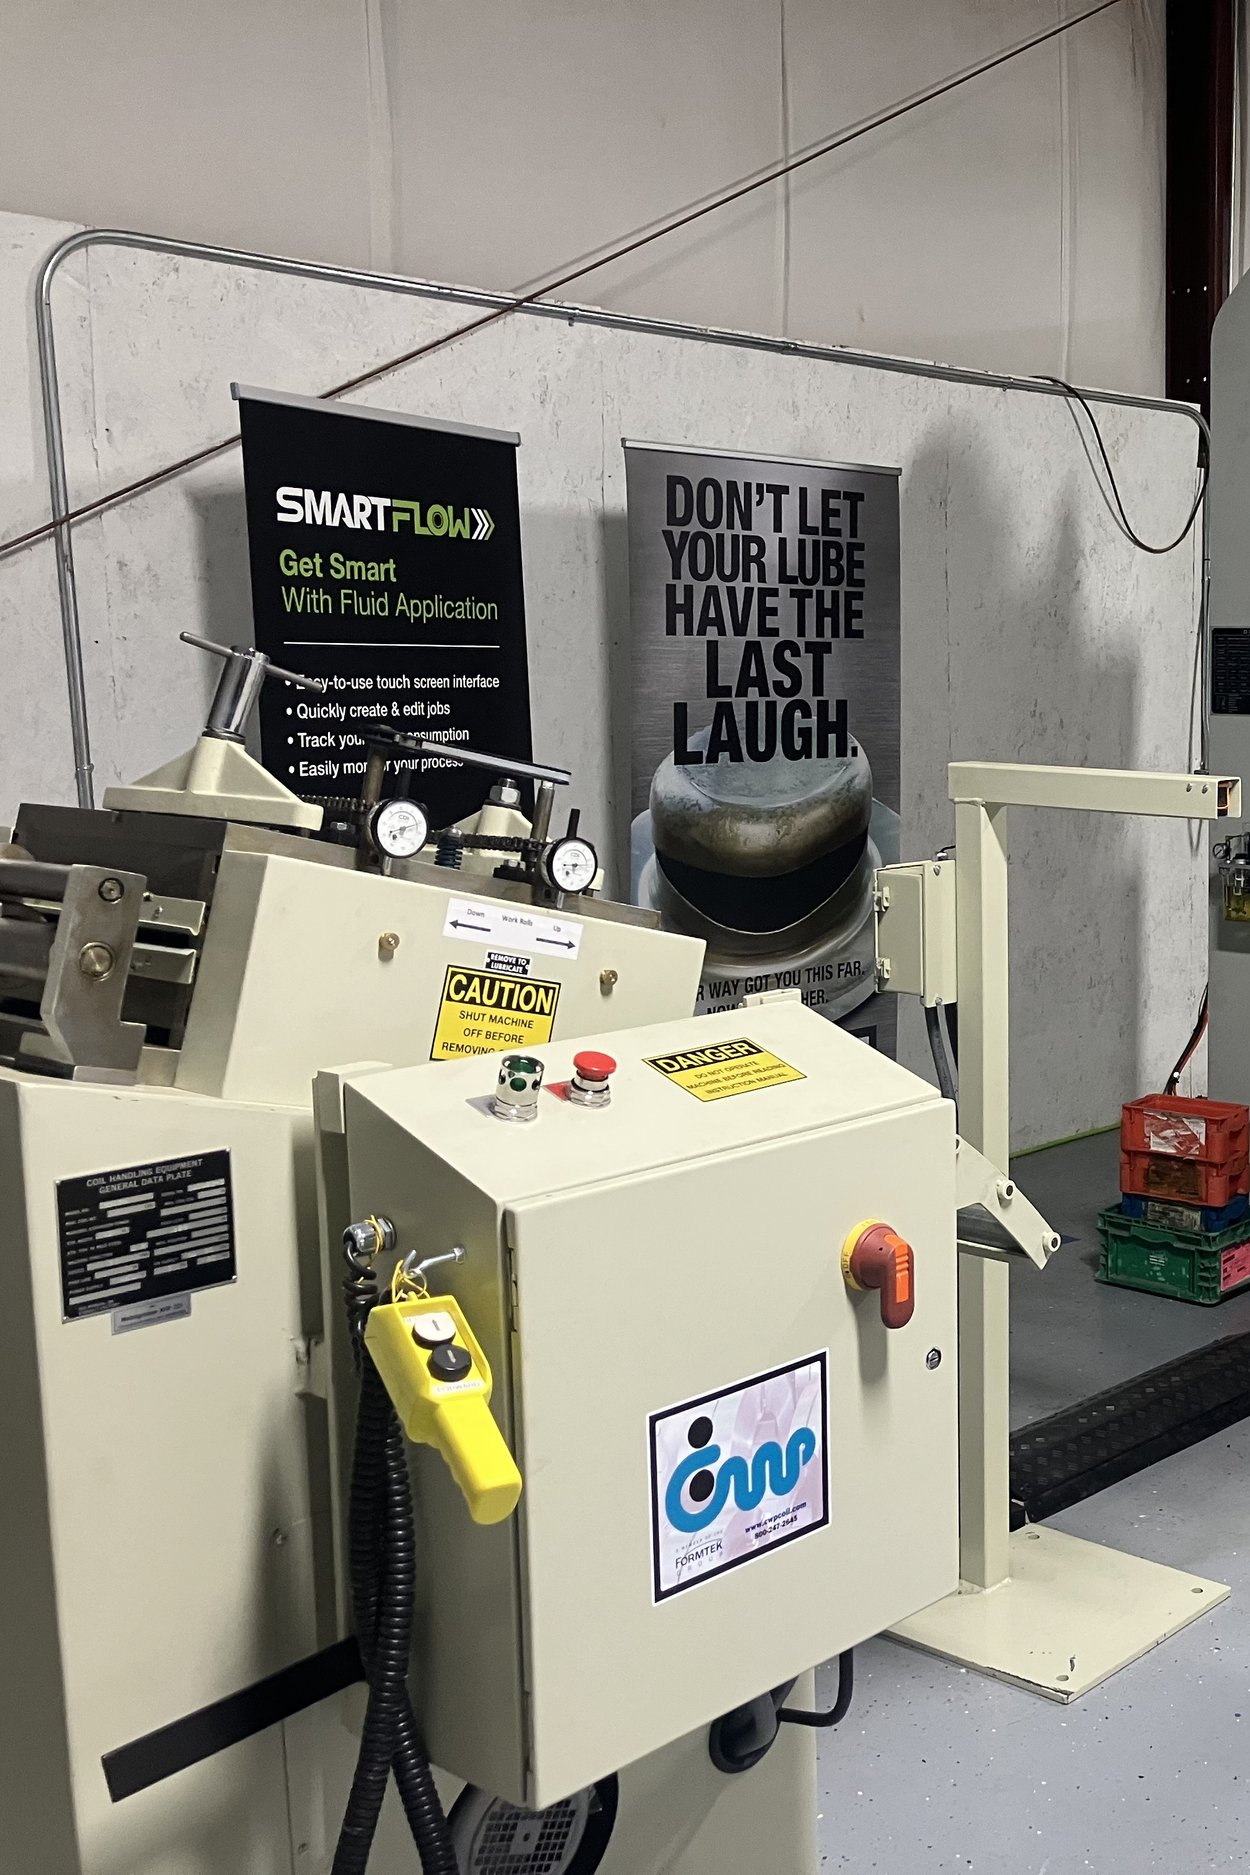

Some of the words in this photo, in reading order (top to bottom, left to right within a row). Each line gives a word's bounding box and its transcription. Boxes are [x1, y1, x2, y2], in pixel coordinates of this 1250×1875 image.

[276, 486, 470, 539] SMARTFLOW
[666, 474, 789, 535] DON'T
[802, 487, 864, 539] LET
[279, 549, 323, 577] Get
[329, 552, 397, 582] Smart
[662, 529, 766, 584] YOUR
[778, 540, 865, 587] LUBE
[281, 586, 332, 615] With
[341, 590, 388, 617] Fluid
[395, 592, 499, 624] Application
[665, 583, 779, 639] HAVE
[793, 587, 864, 639] THE
[706, 639, 832, 698] LAST
[376, 674, 411, 690] touch
[413, 676, 450, 689] screen
[452, 674, 500, 689] interface
[296, 702, 346, 722] Quickly
[349, 704, 388, 718] create
[391, 701, 400, 717] &
[402, 701, 425, 716] edit
[426, 701, 451, 719] jobs
[297, 732, 336, 748] Track
[673, 700, 858, 766] LAUGH.
[299, 761, 339, 779] Easily
[393, 758, 419, 775] your
[467, 908, 485, 918] Down
[502, 915, 518, 924] Work
[519, 918, 533, 927] Rolls
[553, 925, 561, 933] Up
[490, 953, 516, 965] REMOVE
[517, 956, 527, 966] TO
[490, 962, 523, 974] LUBRICATE
[709, 978, 740, 999] WAY
[744, 974, 770, 994] GOT
[774, 970, 801, 988] YOU
[805, 965, 833, 984] THIS
[837, 960, 865, 978] FAR.
[449, 974, 553, 1014] CAUTION
[458, 1010, 487, 1023] SHUT
[488, 1015, 535, 1029] MACHINE
[463, 1027, 483, 1040] OFF
[485, 1030, 525, 1044] BEFORE
[655, 1041, 757, 1072] DANGER
[709, 1068, 725, 1077] NOT
[725, 1061, 760, 1073] OPERATE
[686, 1078, 722, 1090] MACHINE
[724, 1071, 751, 1082] BEFORE
[753, 1063, 786, 1075] READING
[705, 1080, 755, 1094] INSTRUCTION
[756, 1072, 789, 1083] MANUAL
[86, 1177, 106, 1187] COIL
[109, 1169, 153, 1183] HANDLING
[155, 1159, 203, 1174] EQUIPMENT
[99, 1180, 139, 1194] GENERAL
[141, 1176, 164, 1186] DATA
[166, 1170, 192, 1180] PLATE
[675, 1541, 723, 1569] FORMTEK
